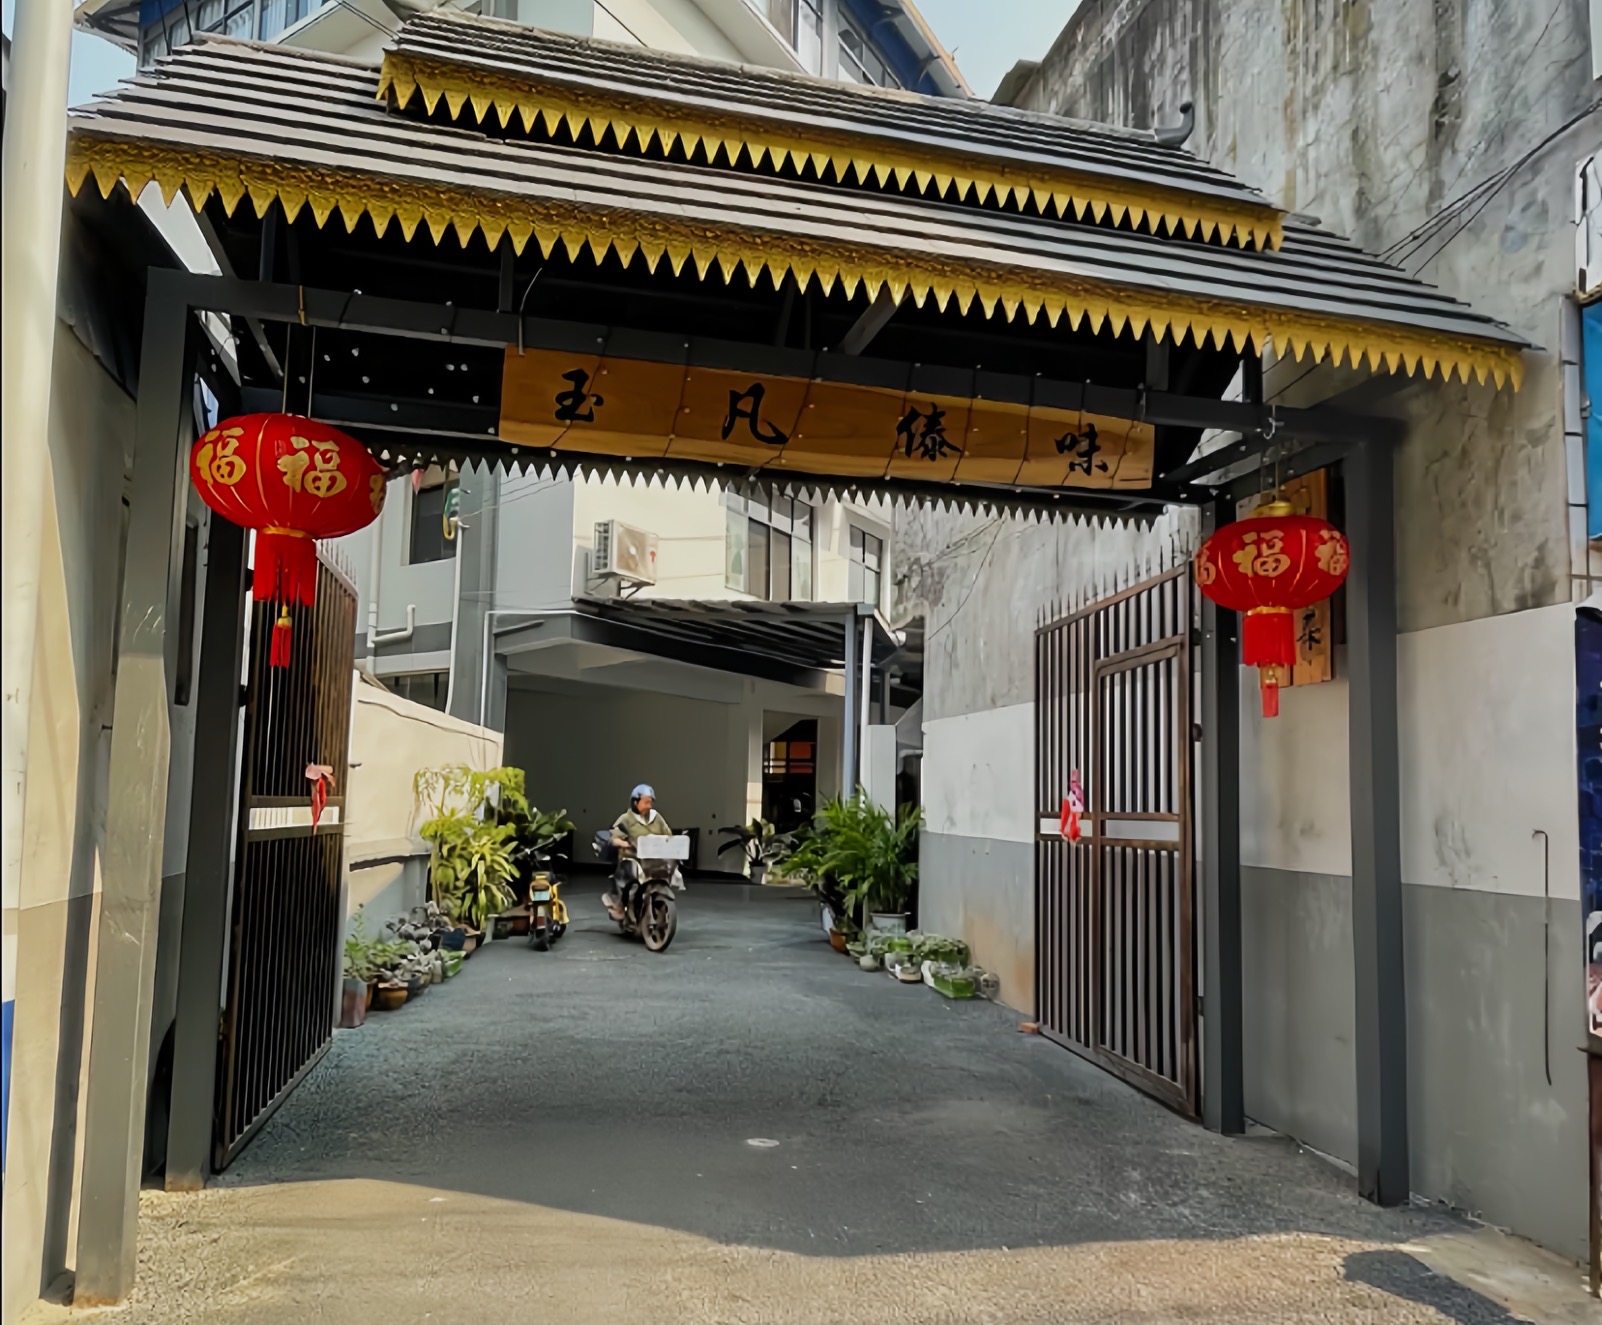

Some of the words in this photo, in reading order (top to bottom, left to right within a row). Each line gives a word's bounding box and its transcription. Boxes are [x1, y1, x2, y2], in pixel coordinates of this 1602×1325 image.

[196, 427, 246, 486] 福
[277, 436, 347, 498] 福
[1232, 529, 1291, 578] 福
